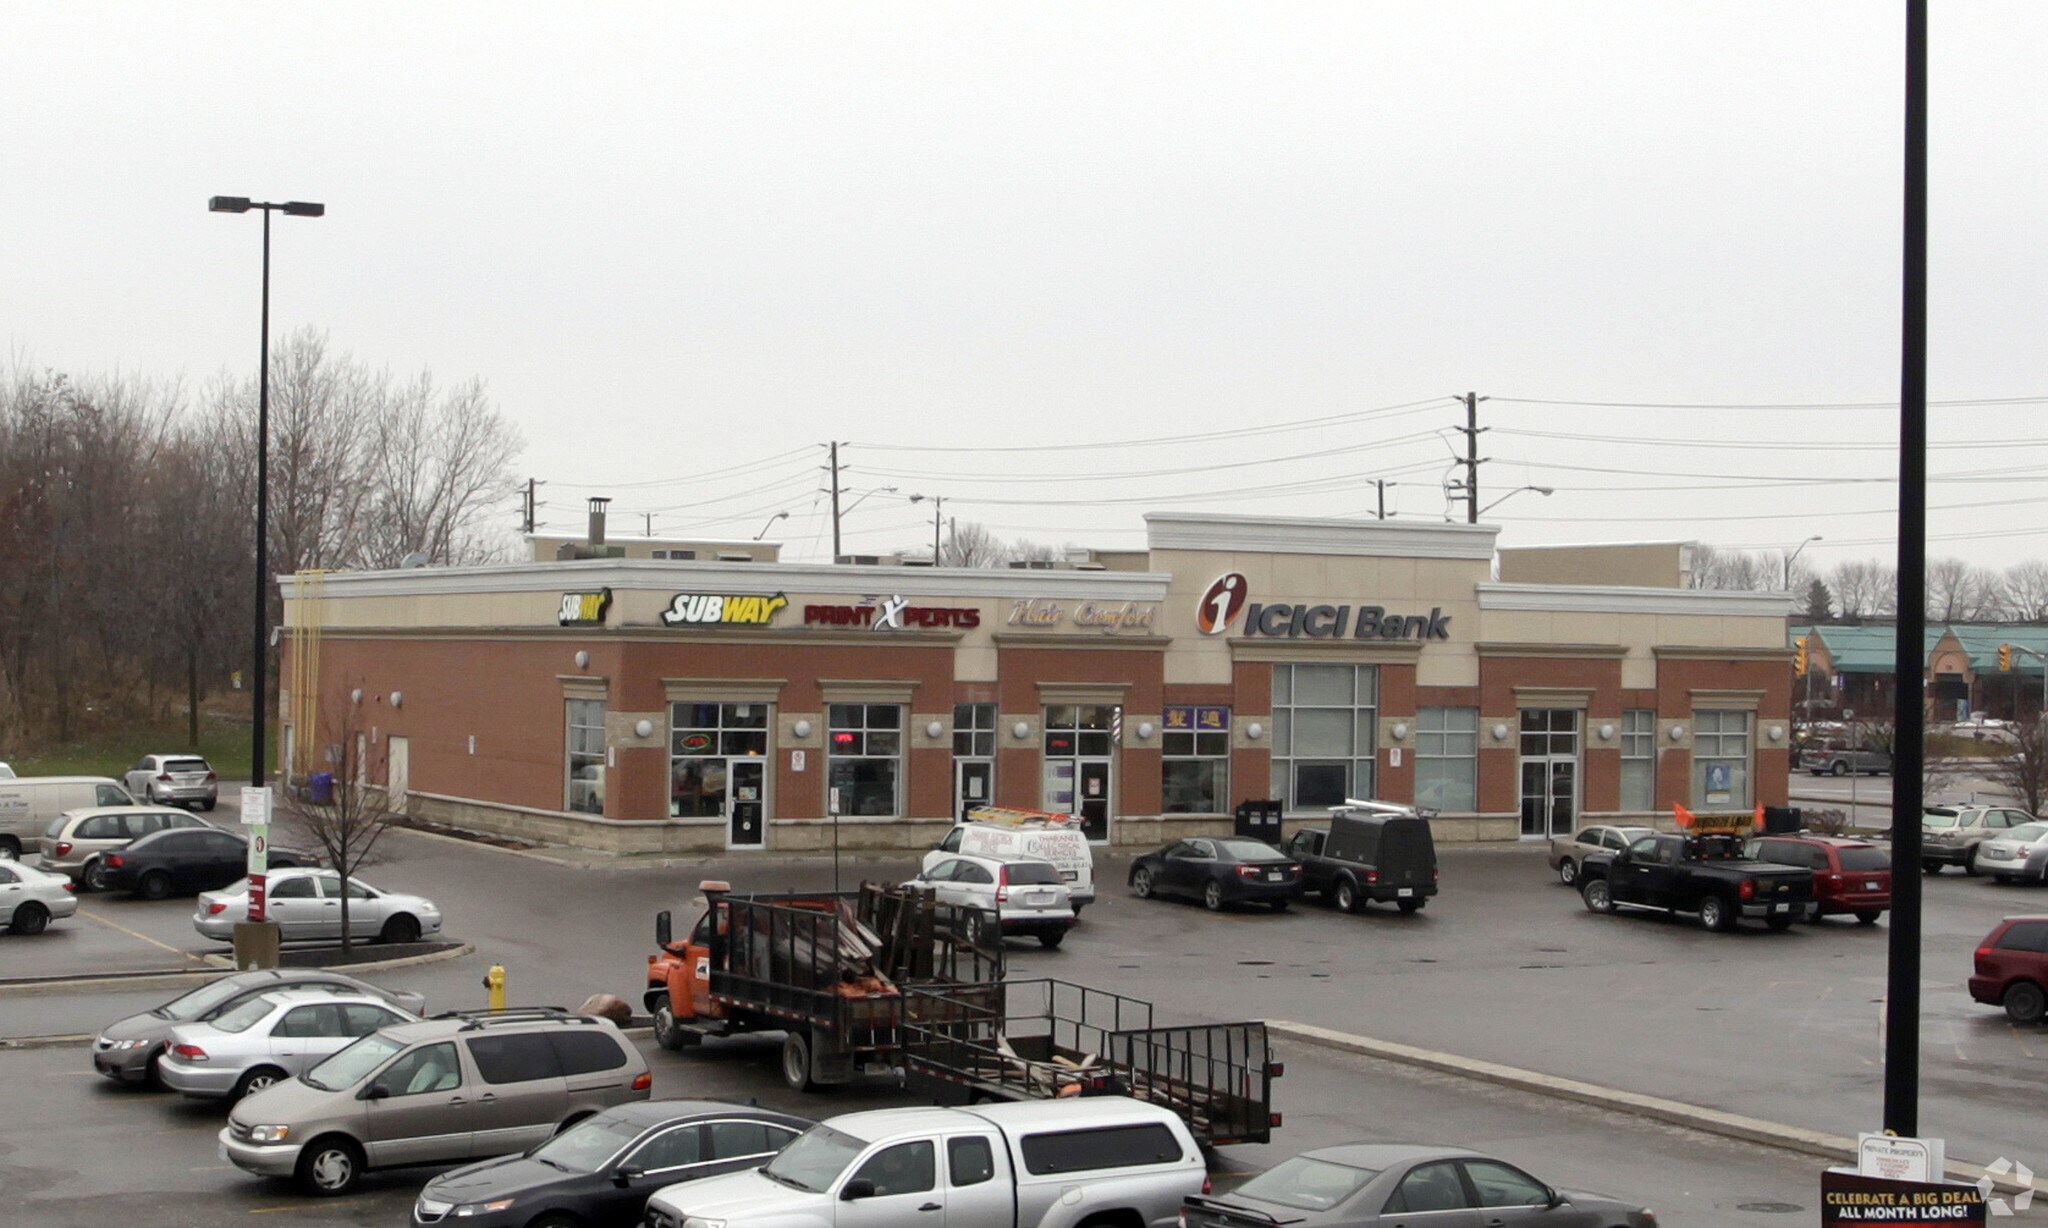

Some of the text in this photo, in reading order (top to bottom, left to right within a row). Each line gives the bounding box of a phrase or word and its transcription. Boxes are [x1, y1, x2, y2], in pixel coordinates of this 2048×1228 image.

[559, 594, 606, 620] SUBWAY
[664, 595, 787, 623] SUBWAY
[1008, 598, 1155, 635] Hair Comfort
[1243, 603, 1452, 639] ICICI Bank
[1826, 1191, 1983, 1205] CELEBRATE A BIG DEAL
[1839, 1205, 1968, 1219] ALL MONTH LONG!
